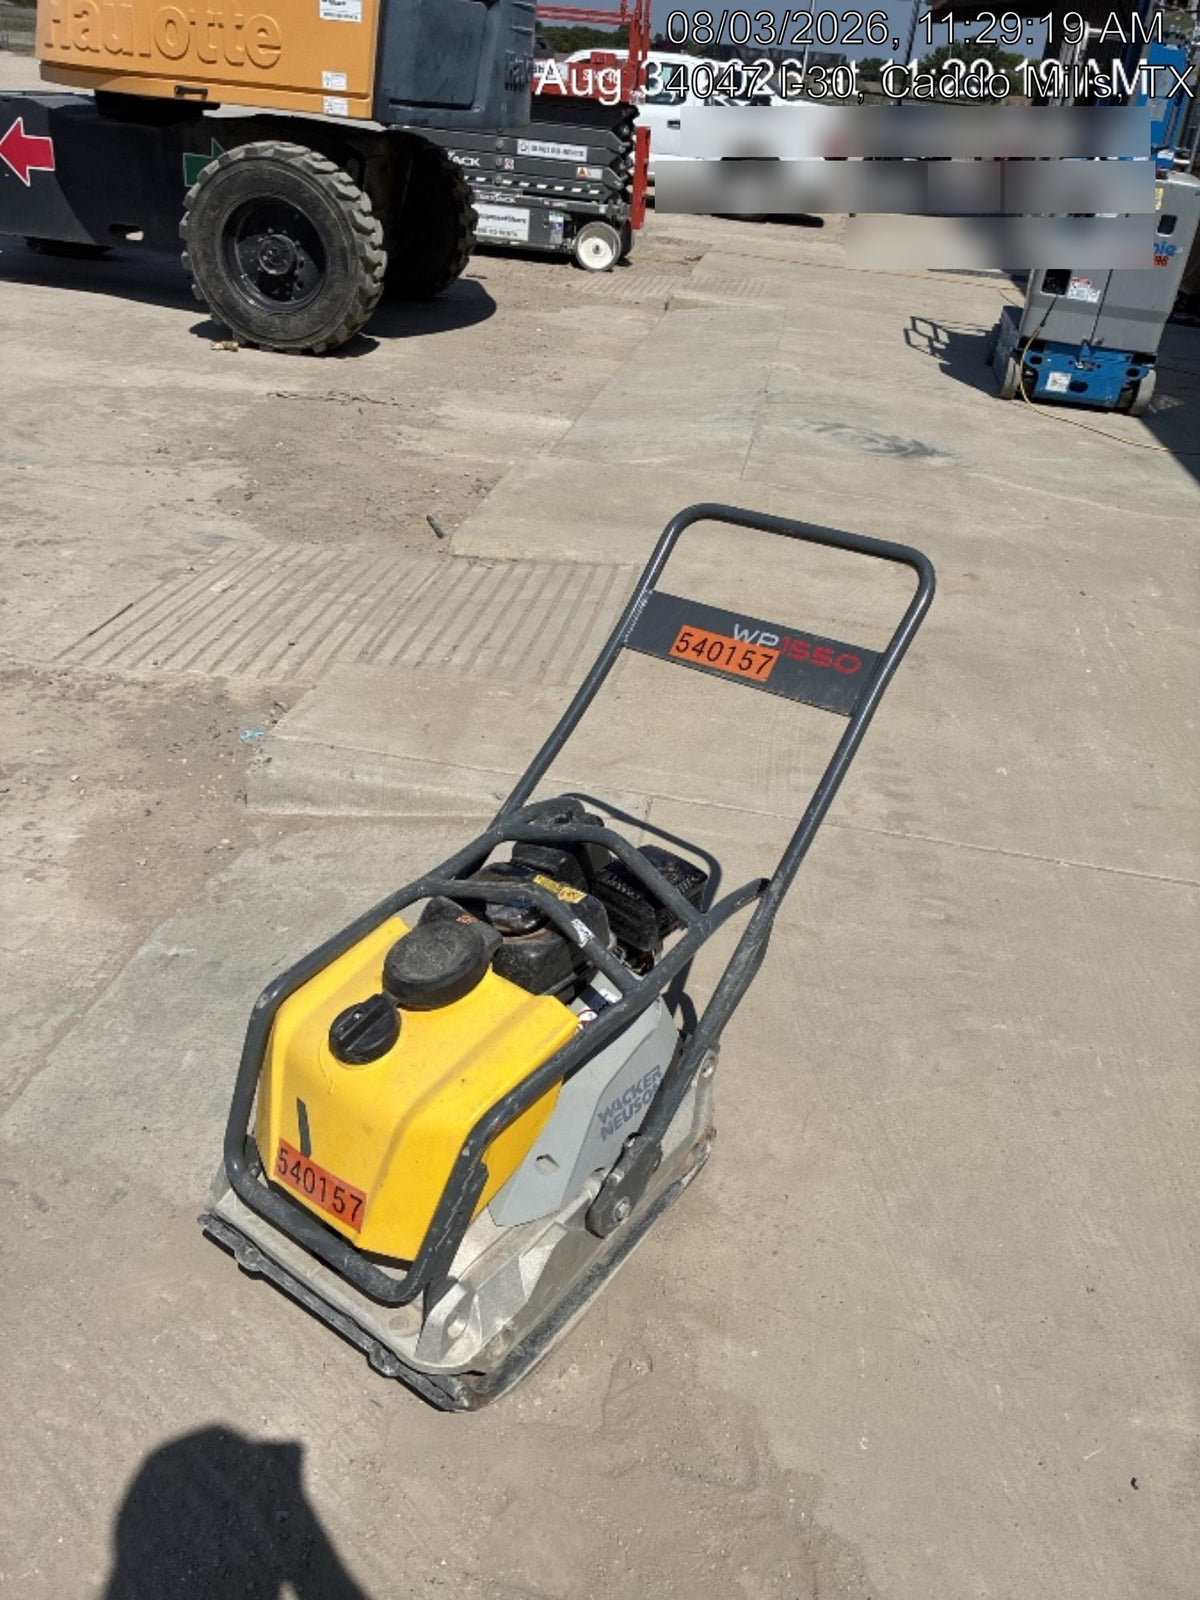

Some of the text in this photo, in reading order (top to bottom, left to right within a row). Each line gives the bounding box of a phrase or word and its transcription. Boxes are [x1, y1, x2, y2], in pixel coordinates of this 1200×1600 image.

[675, 632, 774, 675] 540157
[597, 1064, 662, 1123] WACKER
[600, 1082, 659, 1141] NEUSO
[278, 1148, 364, 1222] 540157
